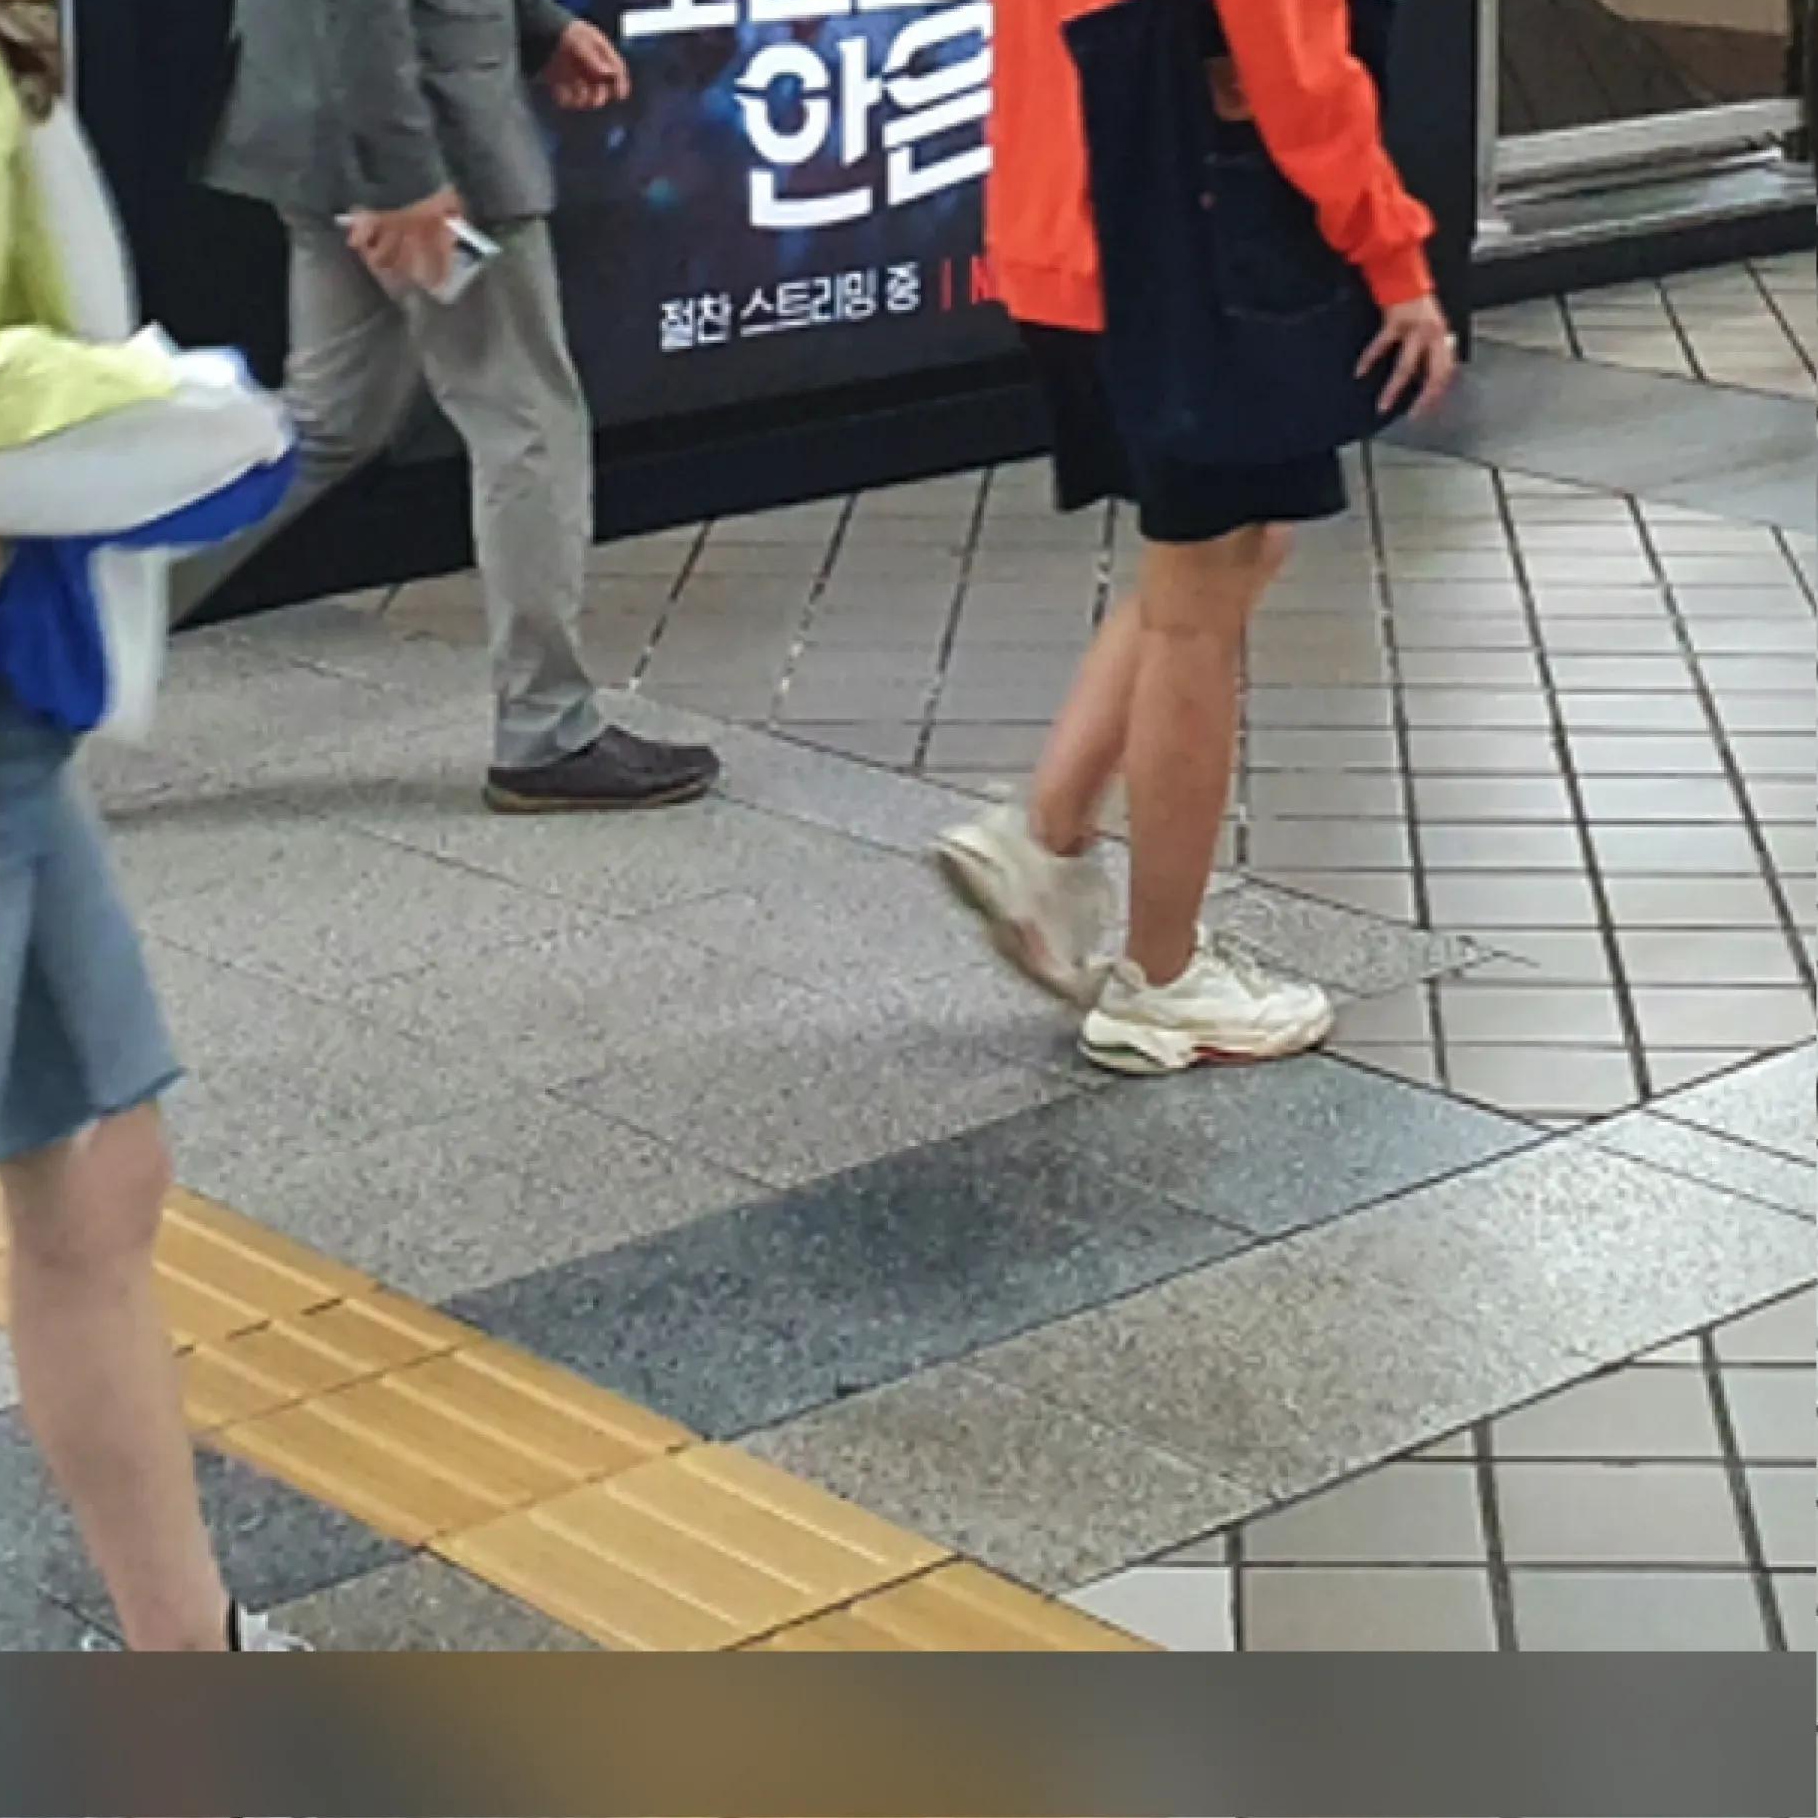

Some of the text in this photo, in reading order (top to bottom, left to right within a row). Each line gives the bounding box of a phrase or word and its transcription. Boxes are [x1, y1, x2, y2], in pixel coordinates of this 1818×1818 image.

[659, 293, 732, 352] 절찬
[739, 267, 879, 338] 스트리밍
[885, 261, 921, 312] 중
